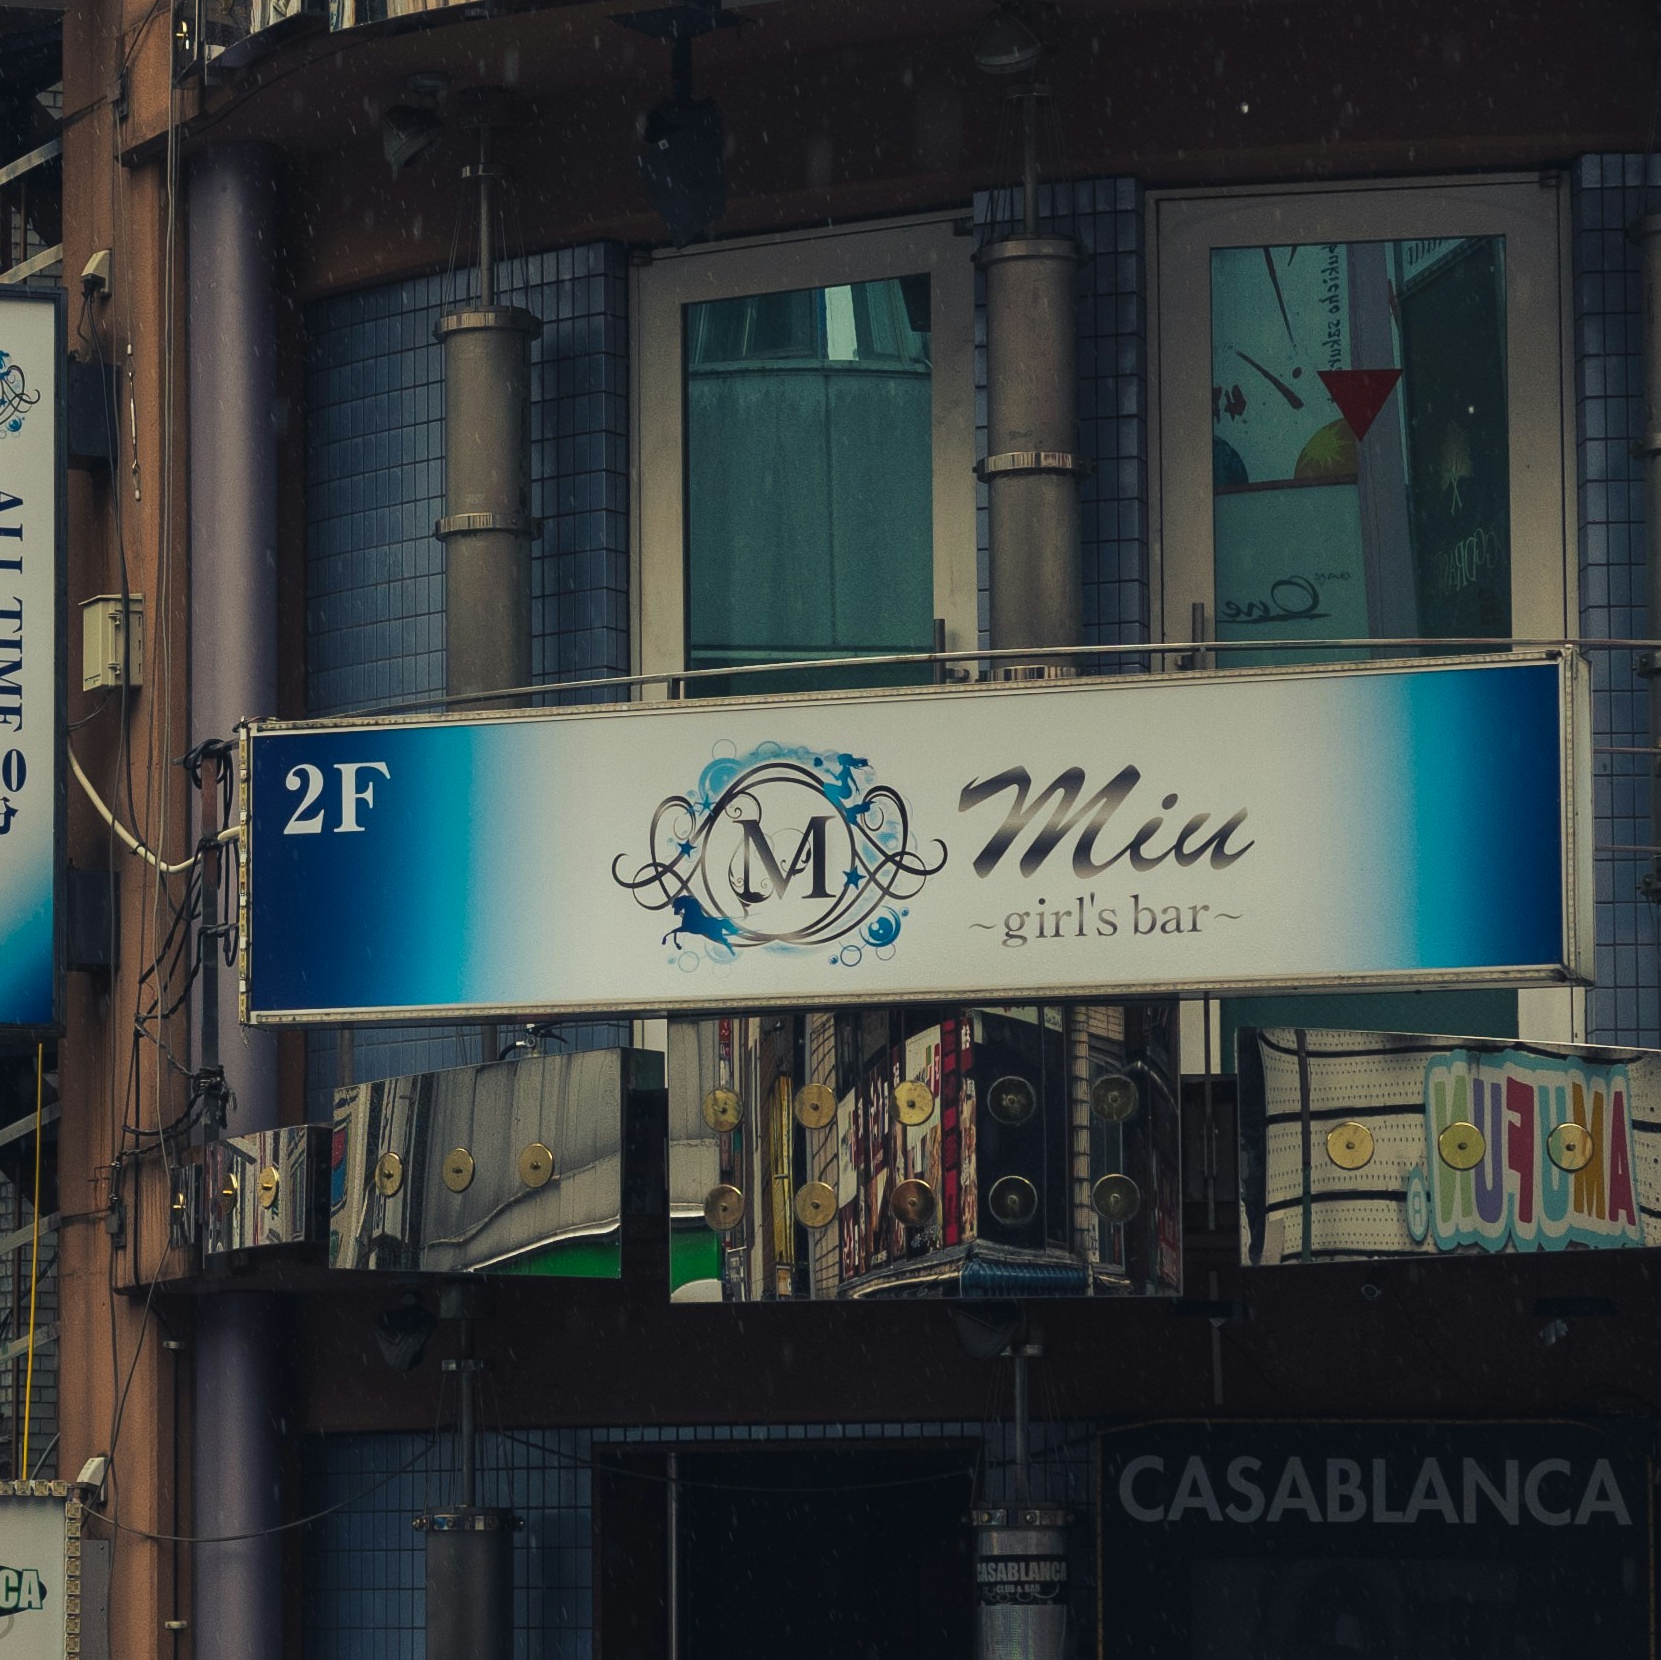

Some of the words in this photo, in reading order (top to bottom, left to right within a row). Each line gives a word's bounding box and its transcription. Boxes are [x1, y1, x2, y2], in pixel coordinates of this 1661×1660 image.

[282, 762, 393, 837] 2F
[957, 763, 1256, 880] Miu
[1118, 1453, 1634, 1527] CASABLANCA
